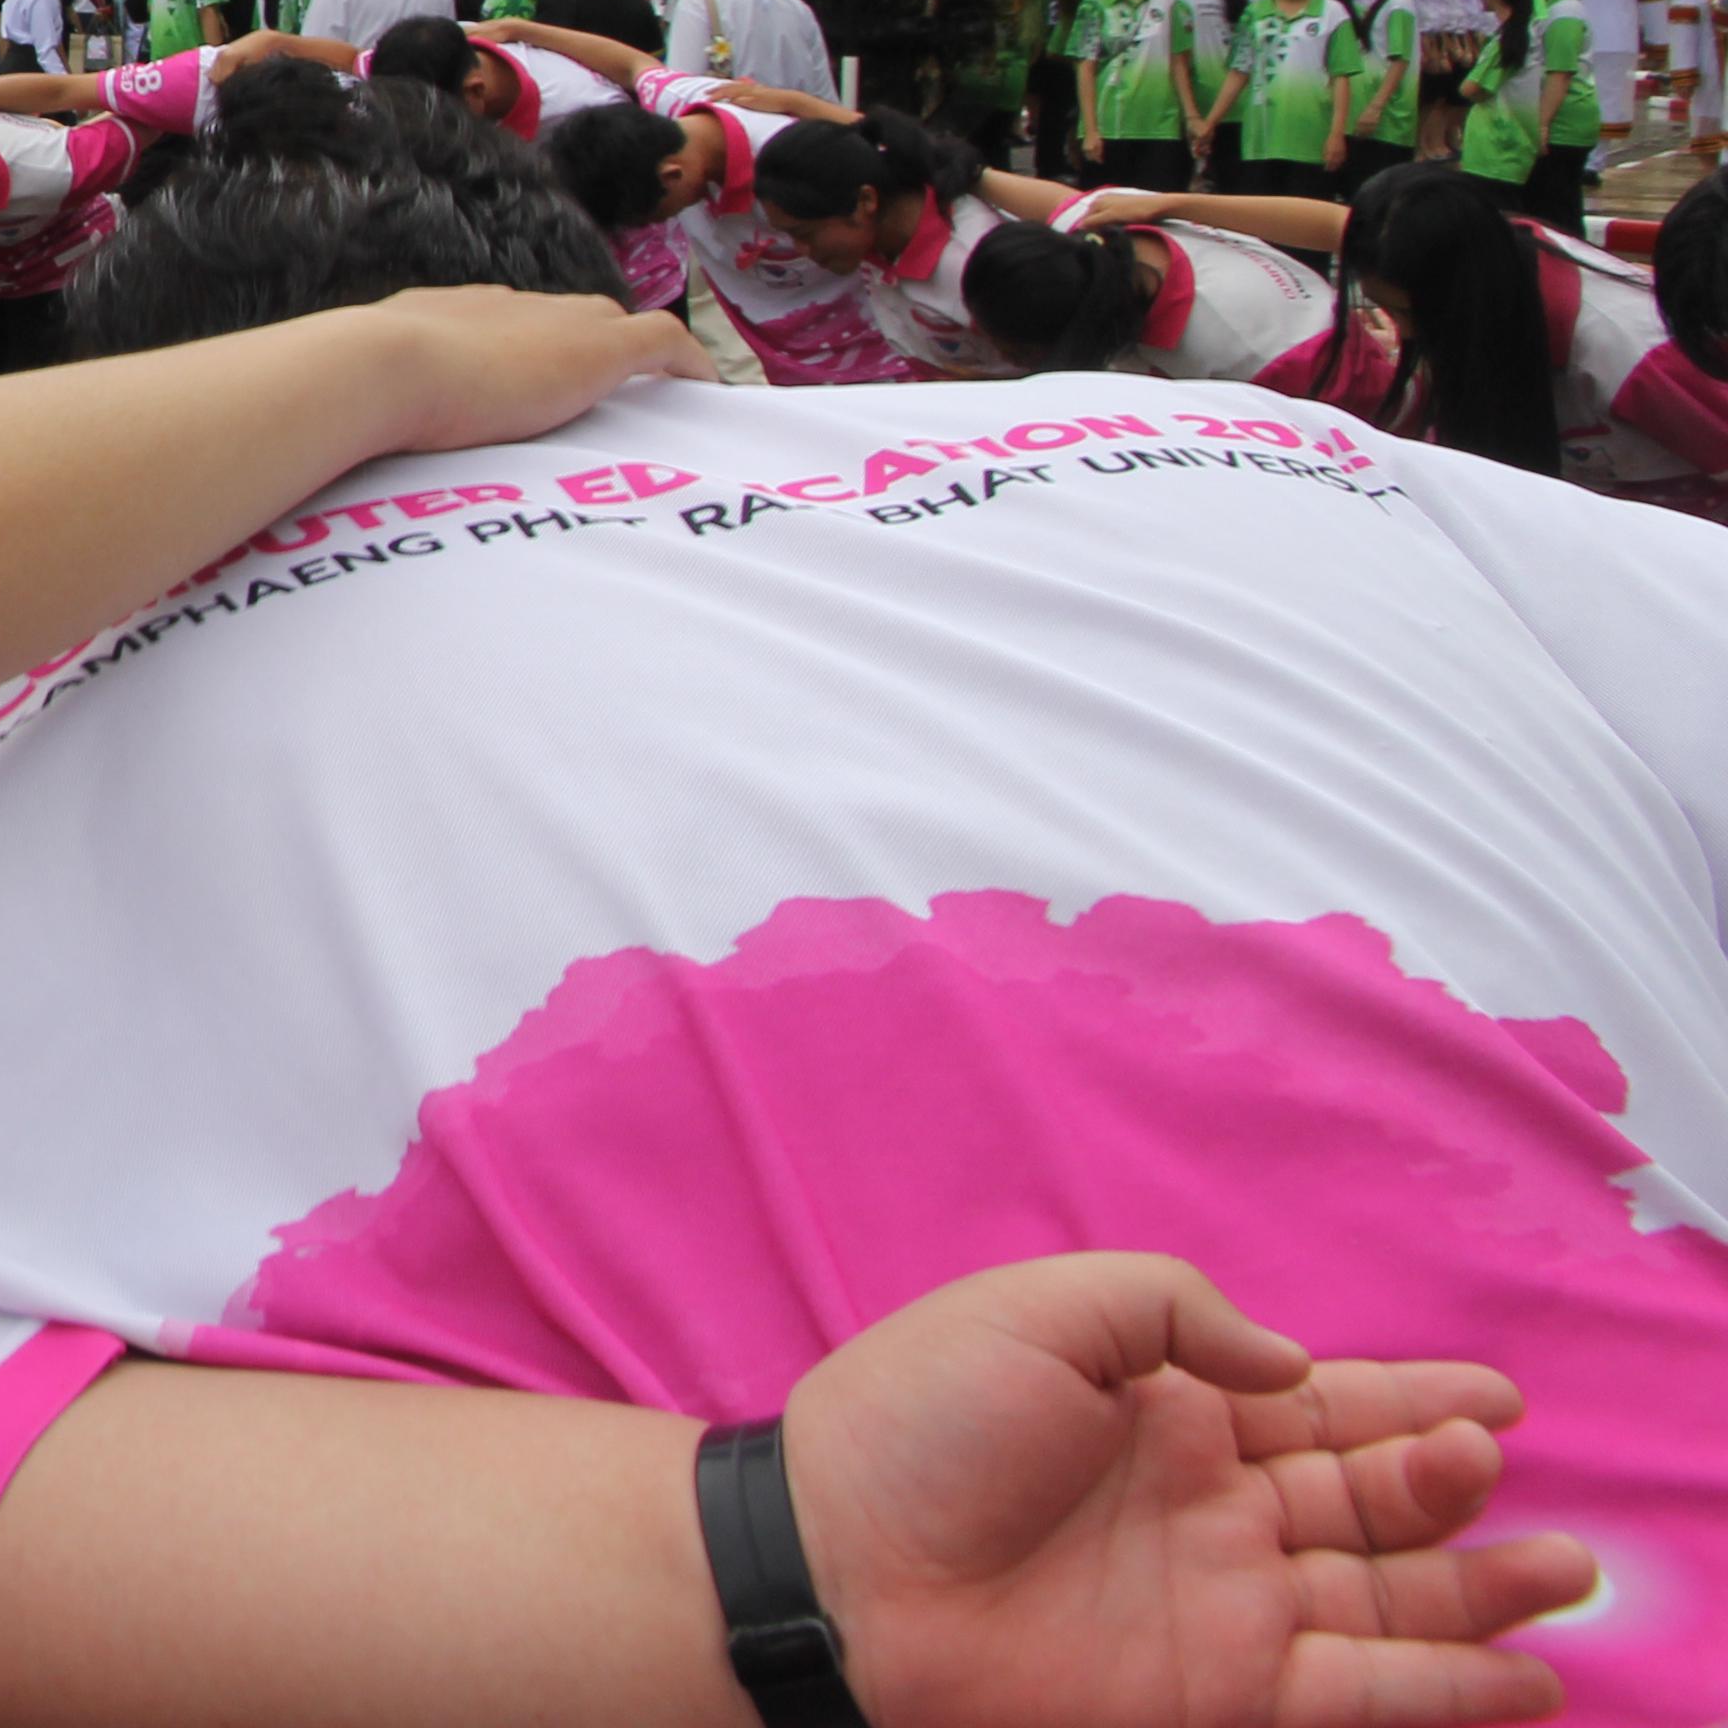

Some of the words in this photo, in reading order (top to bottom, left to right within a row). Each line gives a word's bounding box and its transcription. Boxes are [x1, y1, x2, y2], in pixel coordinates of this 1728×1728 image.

[555, 414, 1163, 504] EDCATION
[679, 464, 1057, 537] RABHAT
[1077, 446, 1410, 517] UNIVERS
